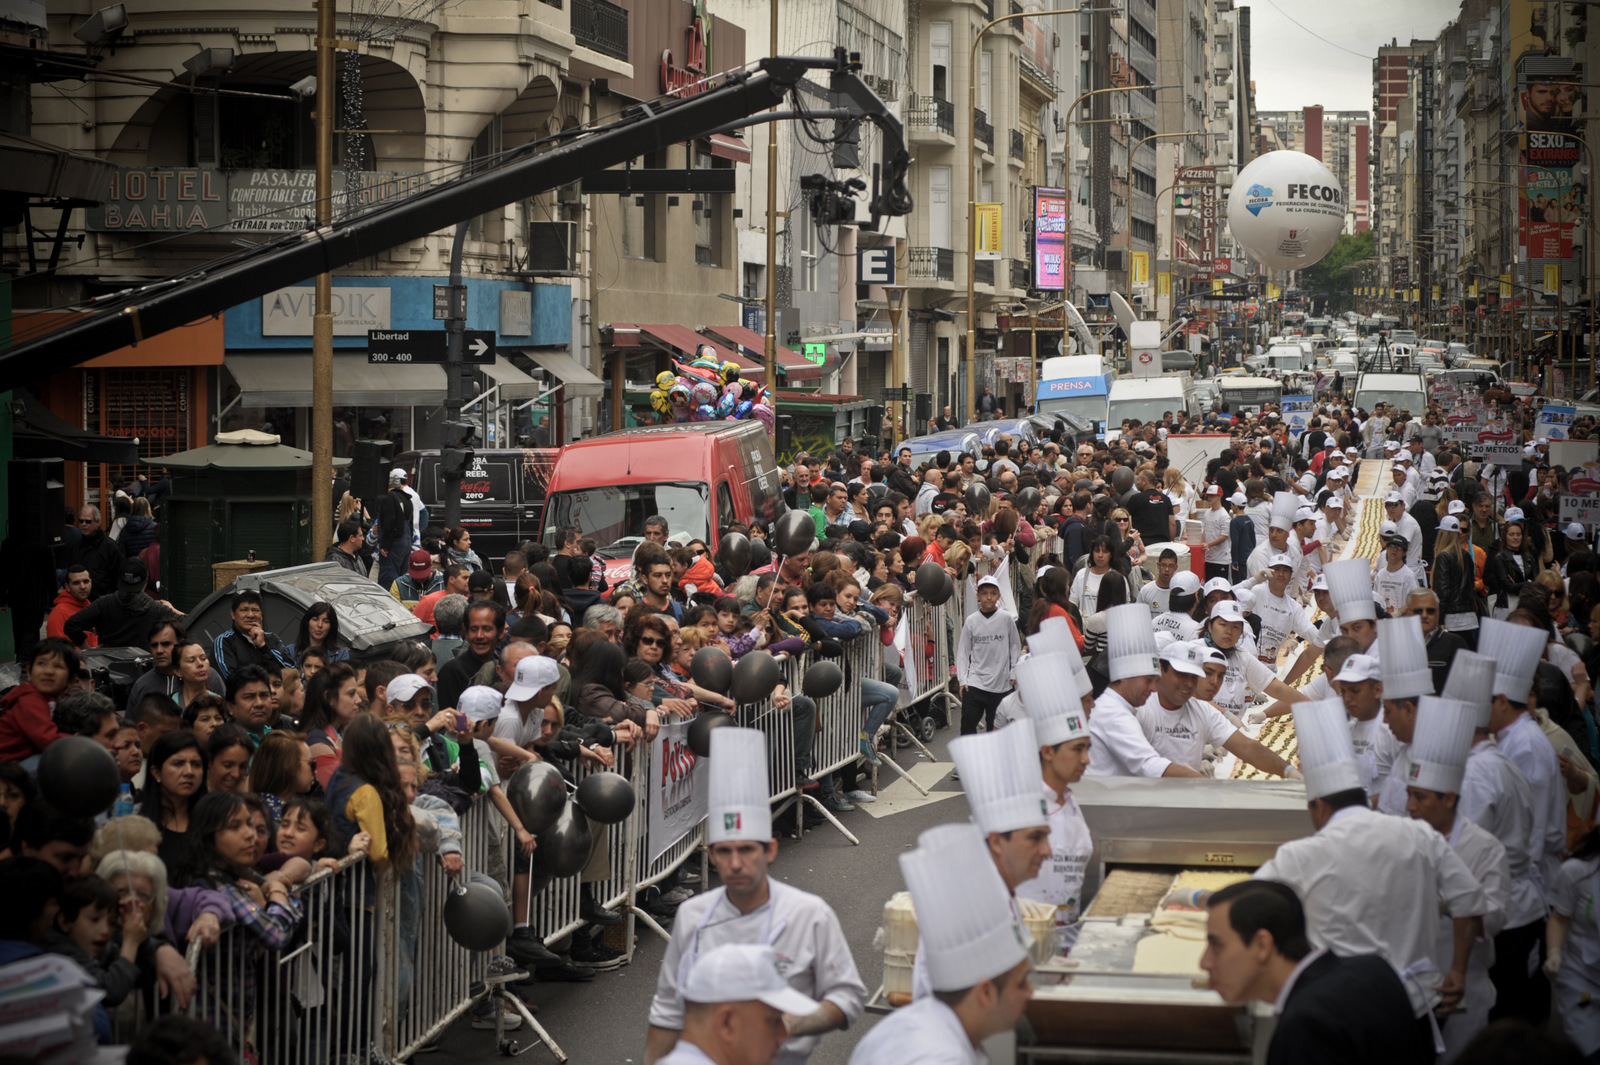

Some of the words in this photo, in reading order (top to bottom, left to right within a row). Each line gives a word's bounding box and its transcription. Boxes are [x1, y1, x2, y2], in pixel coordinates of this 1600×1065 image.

[1530, 134, 1564, 148] SEXO
[1530, 147, 1580, 159] EXTRAÑOS
[1182, 170, 1215, 179] PIZZERIA
[231, 188, 295, 202] CONFORTABLE
[105, 204, 208, 229] BAHIA
[862, 250, 888, 281] E
[372, 332, 409, 340] Libertad
[372, 353, 388, 361] 300
[396, 353, 412, 361] 400
[1050, 381, 1092, 391] PRENSA
[1565, 499, 1578, 507] 10
[1157, 617, 1165, 625] LA
[1164, 618, 1181, 630] PIZZA
